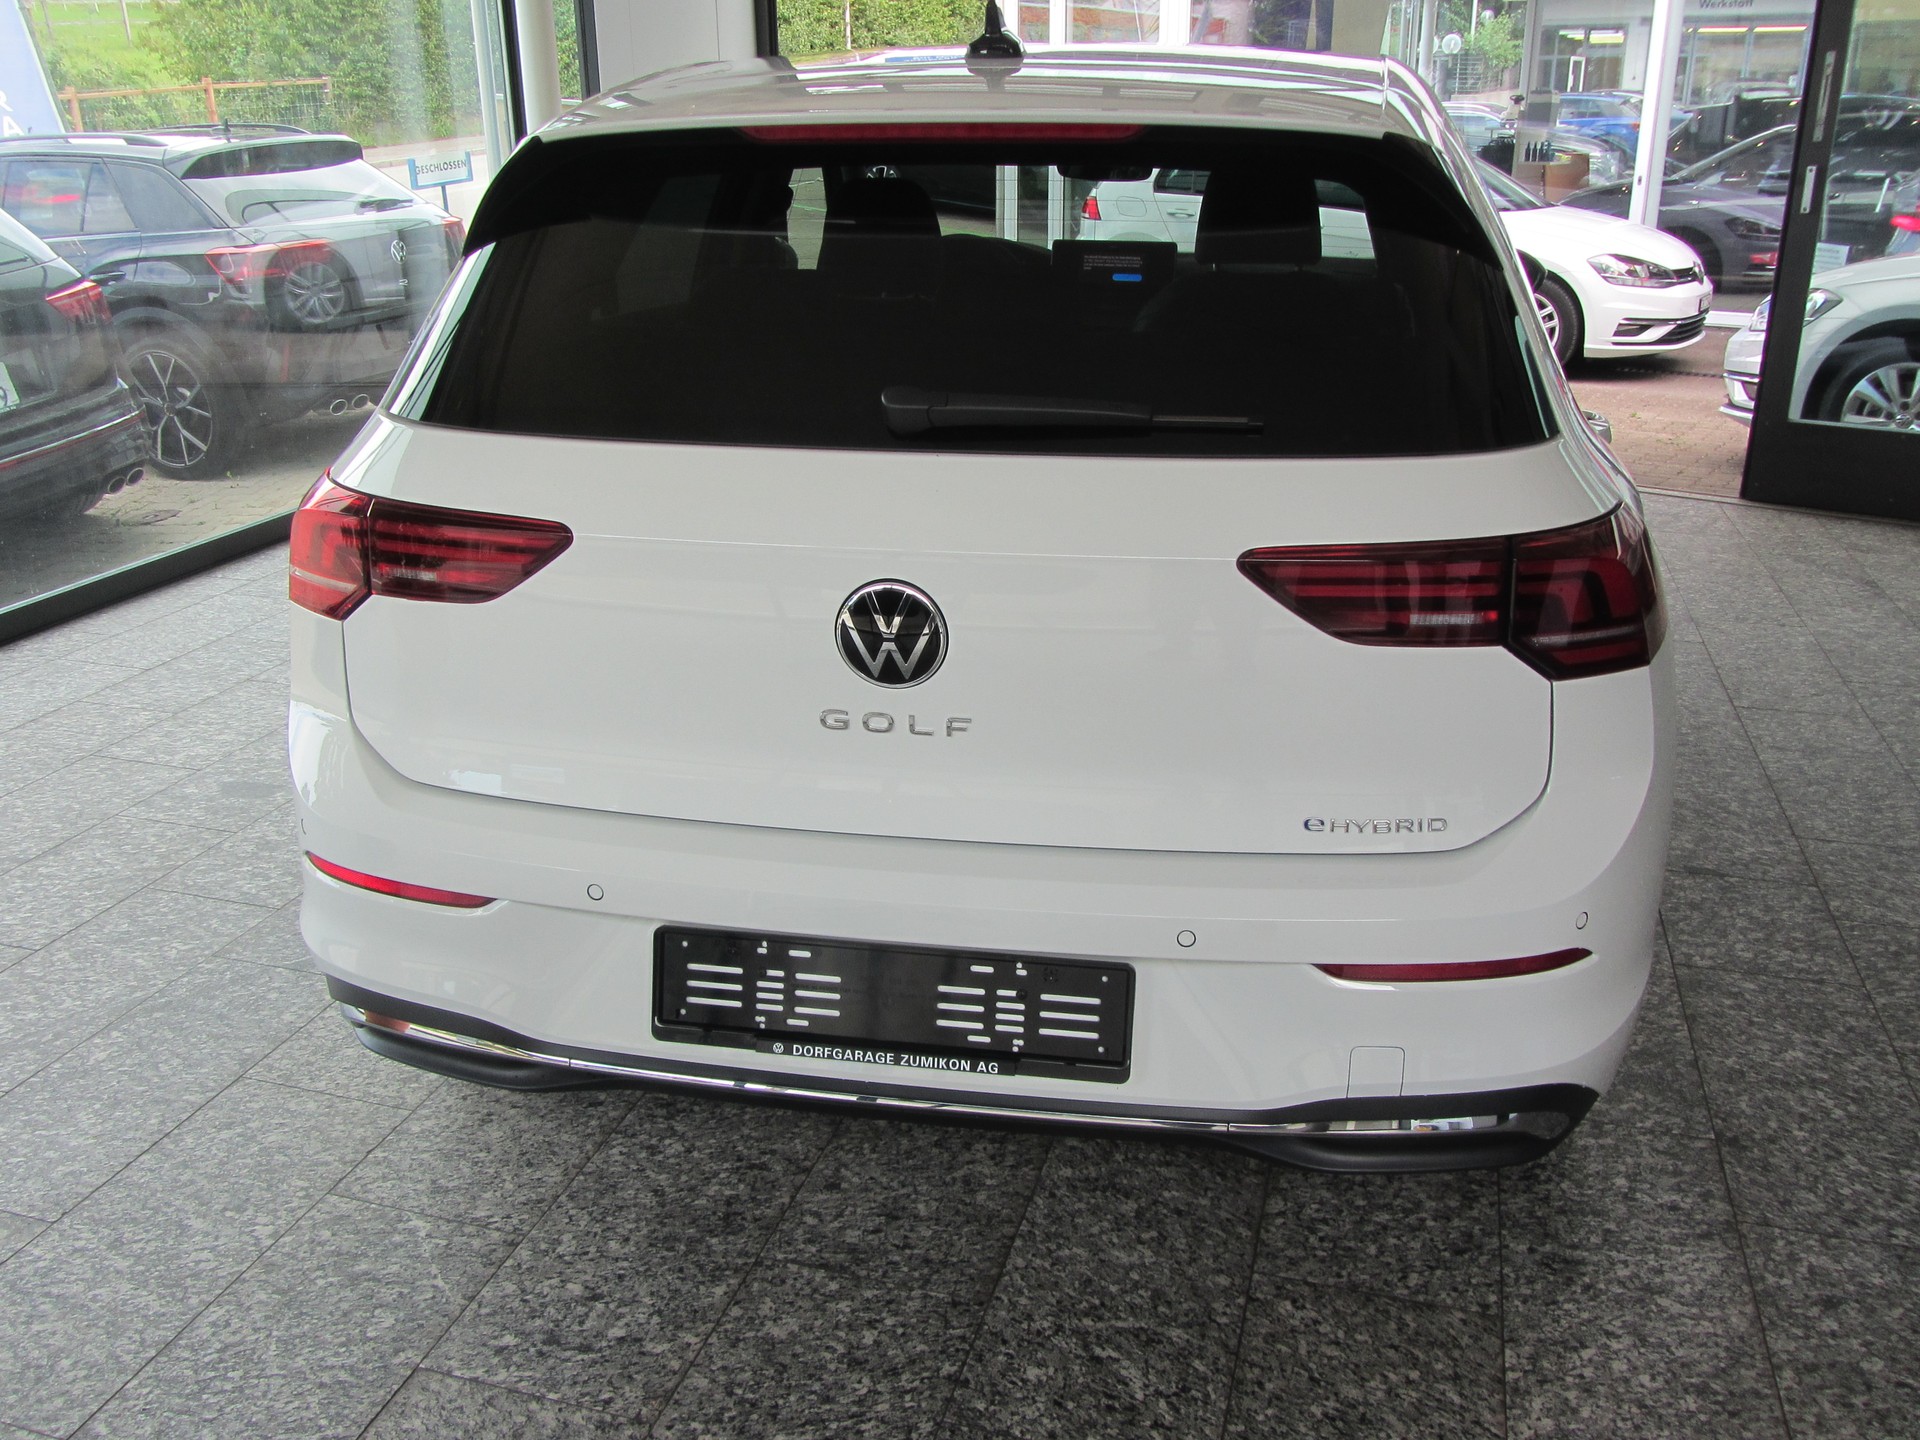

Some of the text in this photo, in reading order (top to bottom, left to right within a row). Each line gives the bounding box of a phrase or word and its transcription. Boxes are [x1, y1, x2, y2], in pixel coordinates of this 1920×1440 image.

[415, 159, 467, 175] GESCHLOSSEN
[837, 580, 947, 688] VW
[819, 708, 972, 738] GOLF
[1303, 817, 1448, 834] eHYBRID
[792, 1044, 895, 1065] DORFGARAGE
[900, 1054, 971, 1072] ZUMIKON
[976, 1062, 999, 1075] AG
